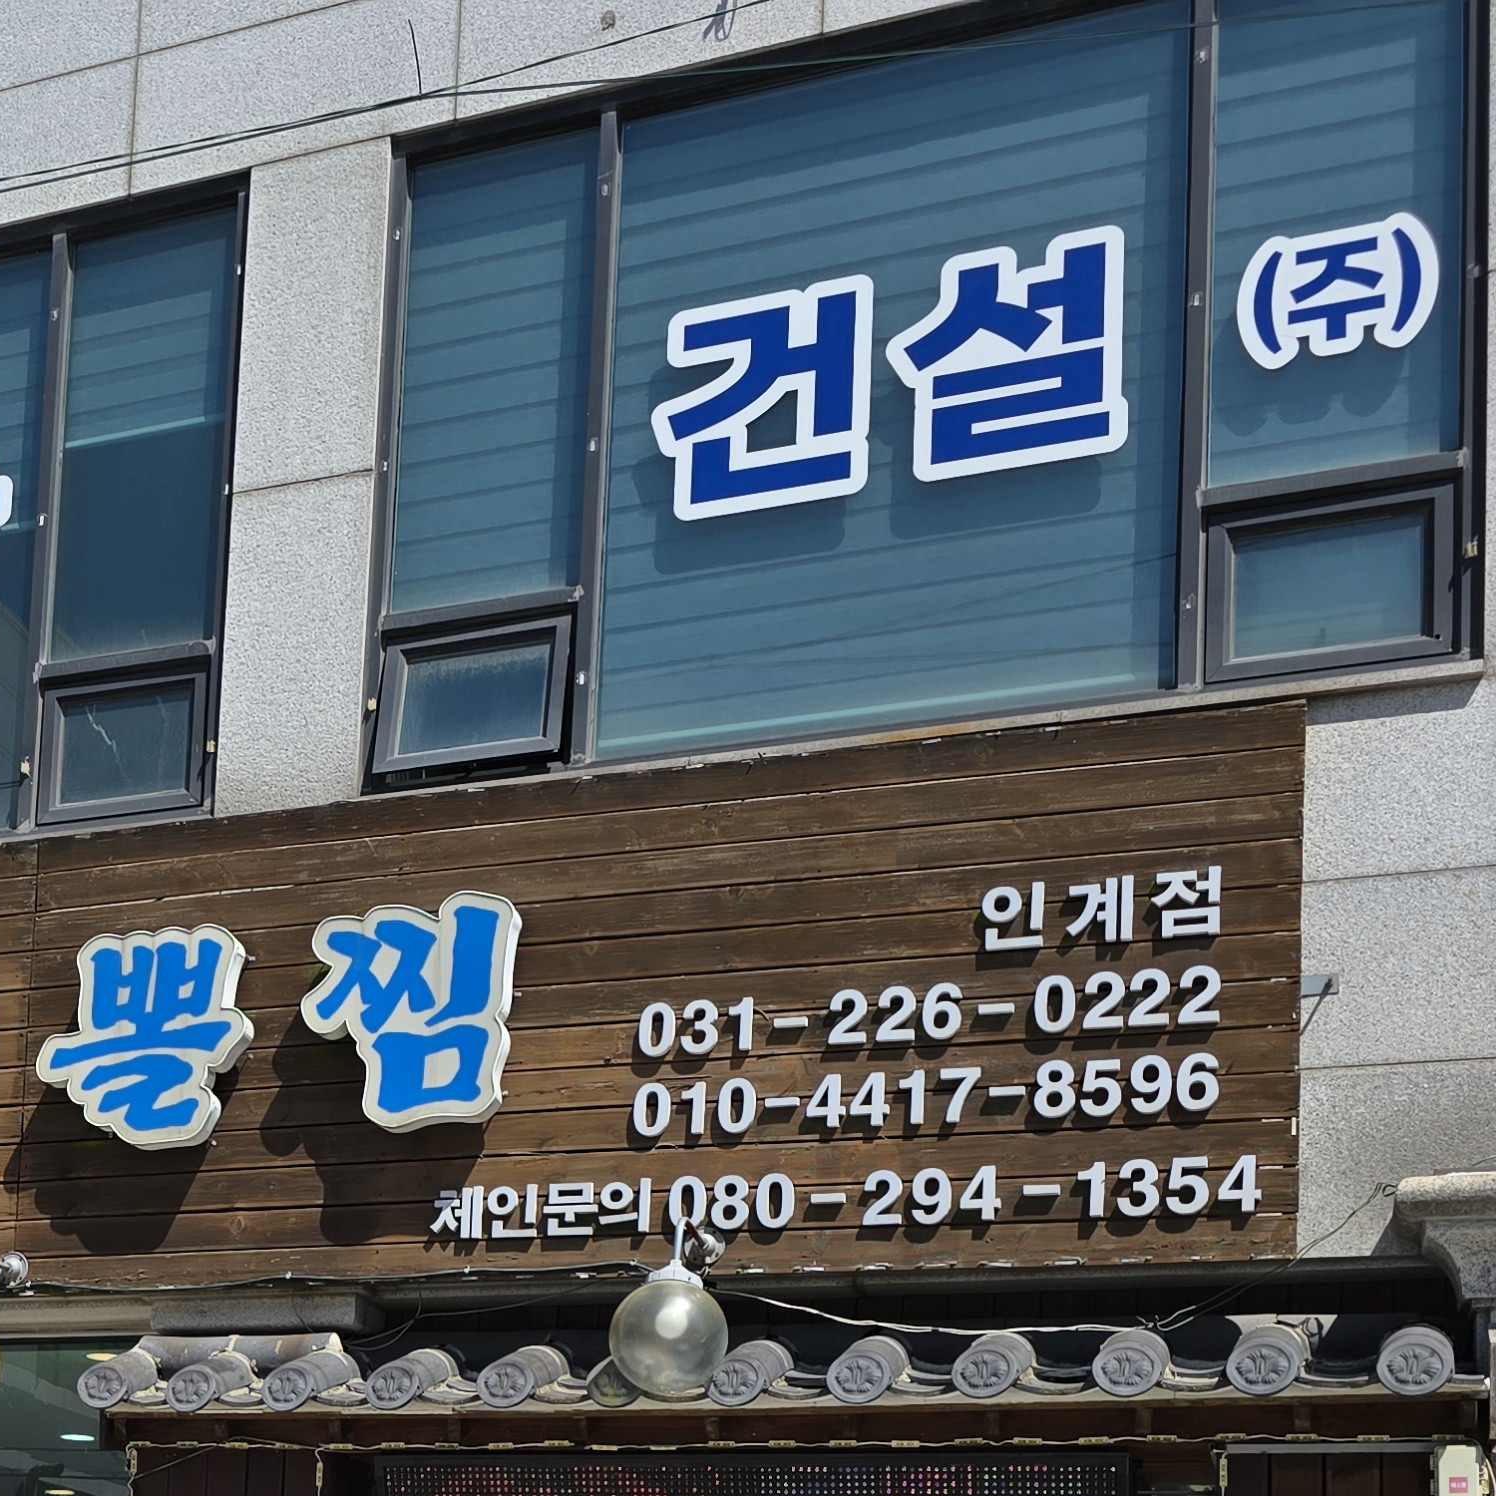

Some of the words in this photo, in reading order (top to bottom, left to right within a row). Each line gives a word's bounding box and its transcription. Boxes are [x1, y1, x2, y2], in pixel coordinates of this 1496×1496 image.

[653, 227, 1126, 518] 건설
[1239, 214, 1437, 368] (주)
[981, 866, 1223, 951] 인계점
[632, 1052, 1221, 1138] 010-4417-8596
[430, 1176, 652, 1240] 체인문의
